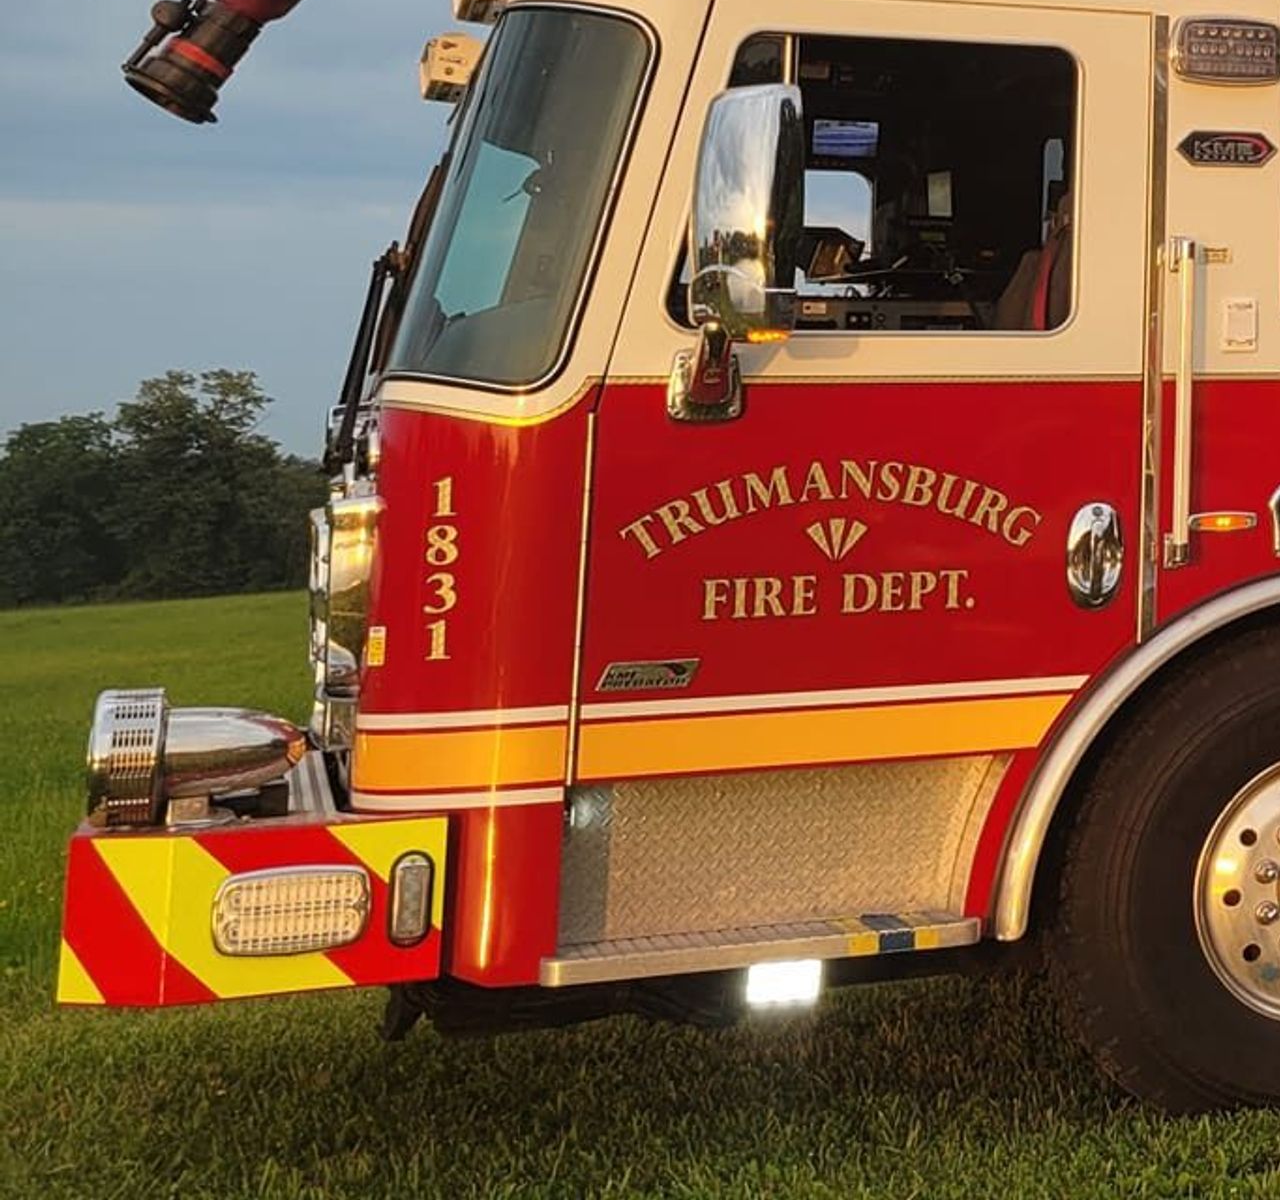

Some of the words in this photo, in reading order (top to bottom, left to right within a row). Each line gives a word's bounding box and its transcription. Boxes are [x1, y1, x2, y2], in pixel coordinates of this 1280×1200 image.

[618, 459, 1042, 559] TRUMANSBURG
[423, 476, 459, 661] 1831
[701, 575, 818, 620] FIRE
[840, 569, 976, 614] DEPT.
